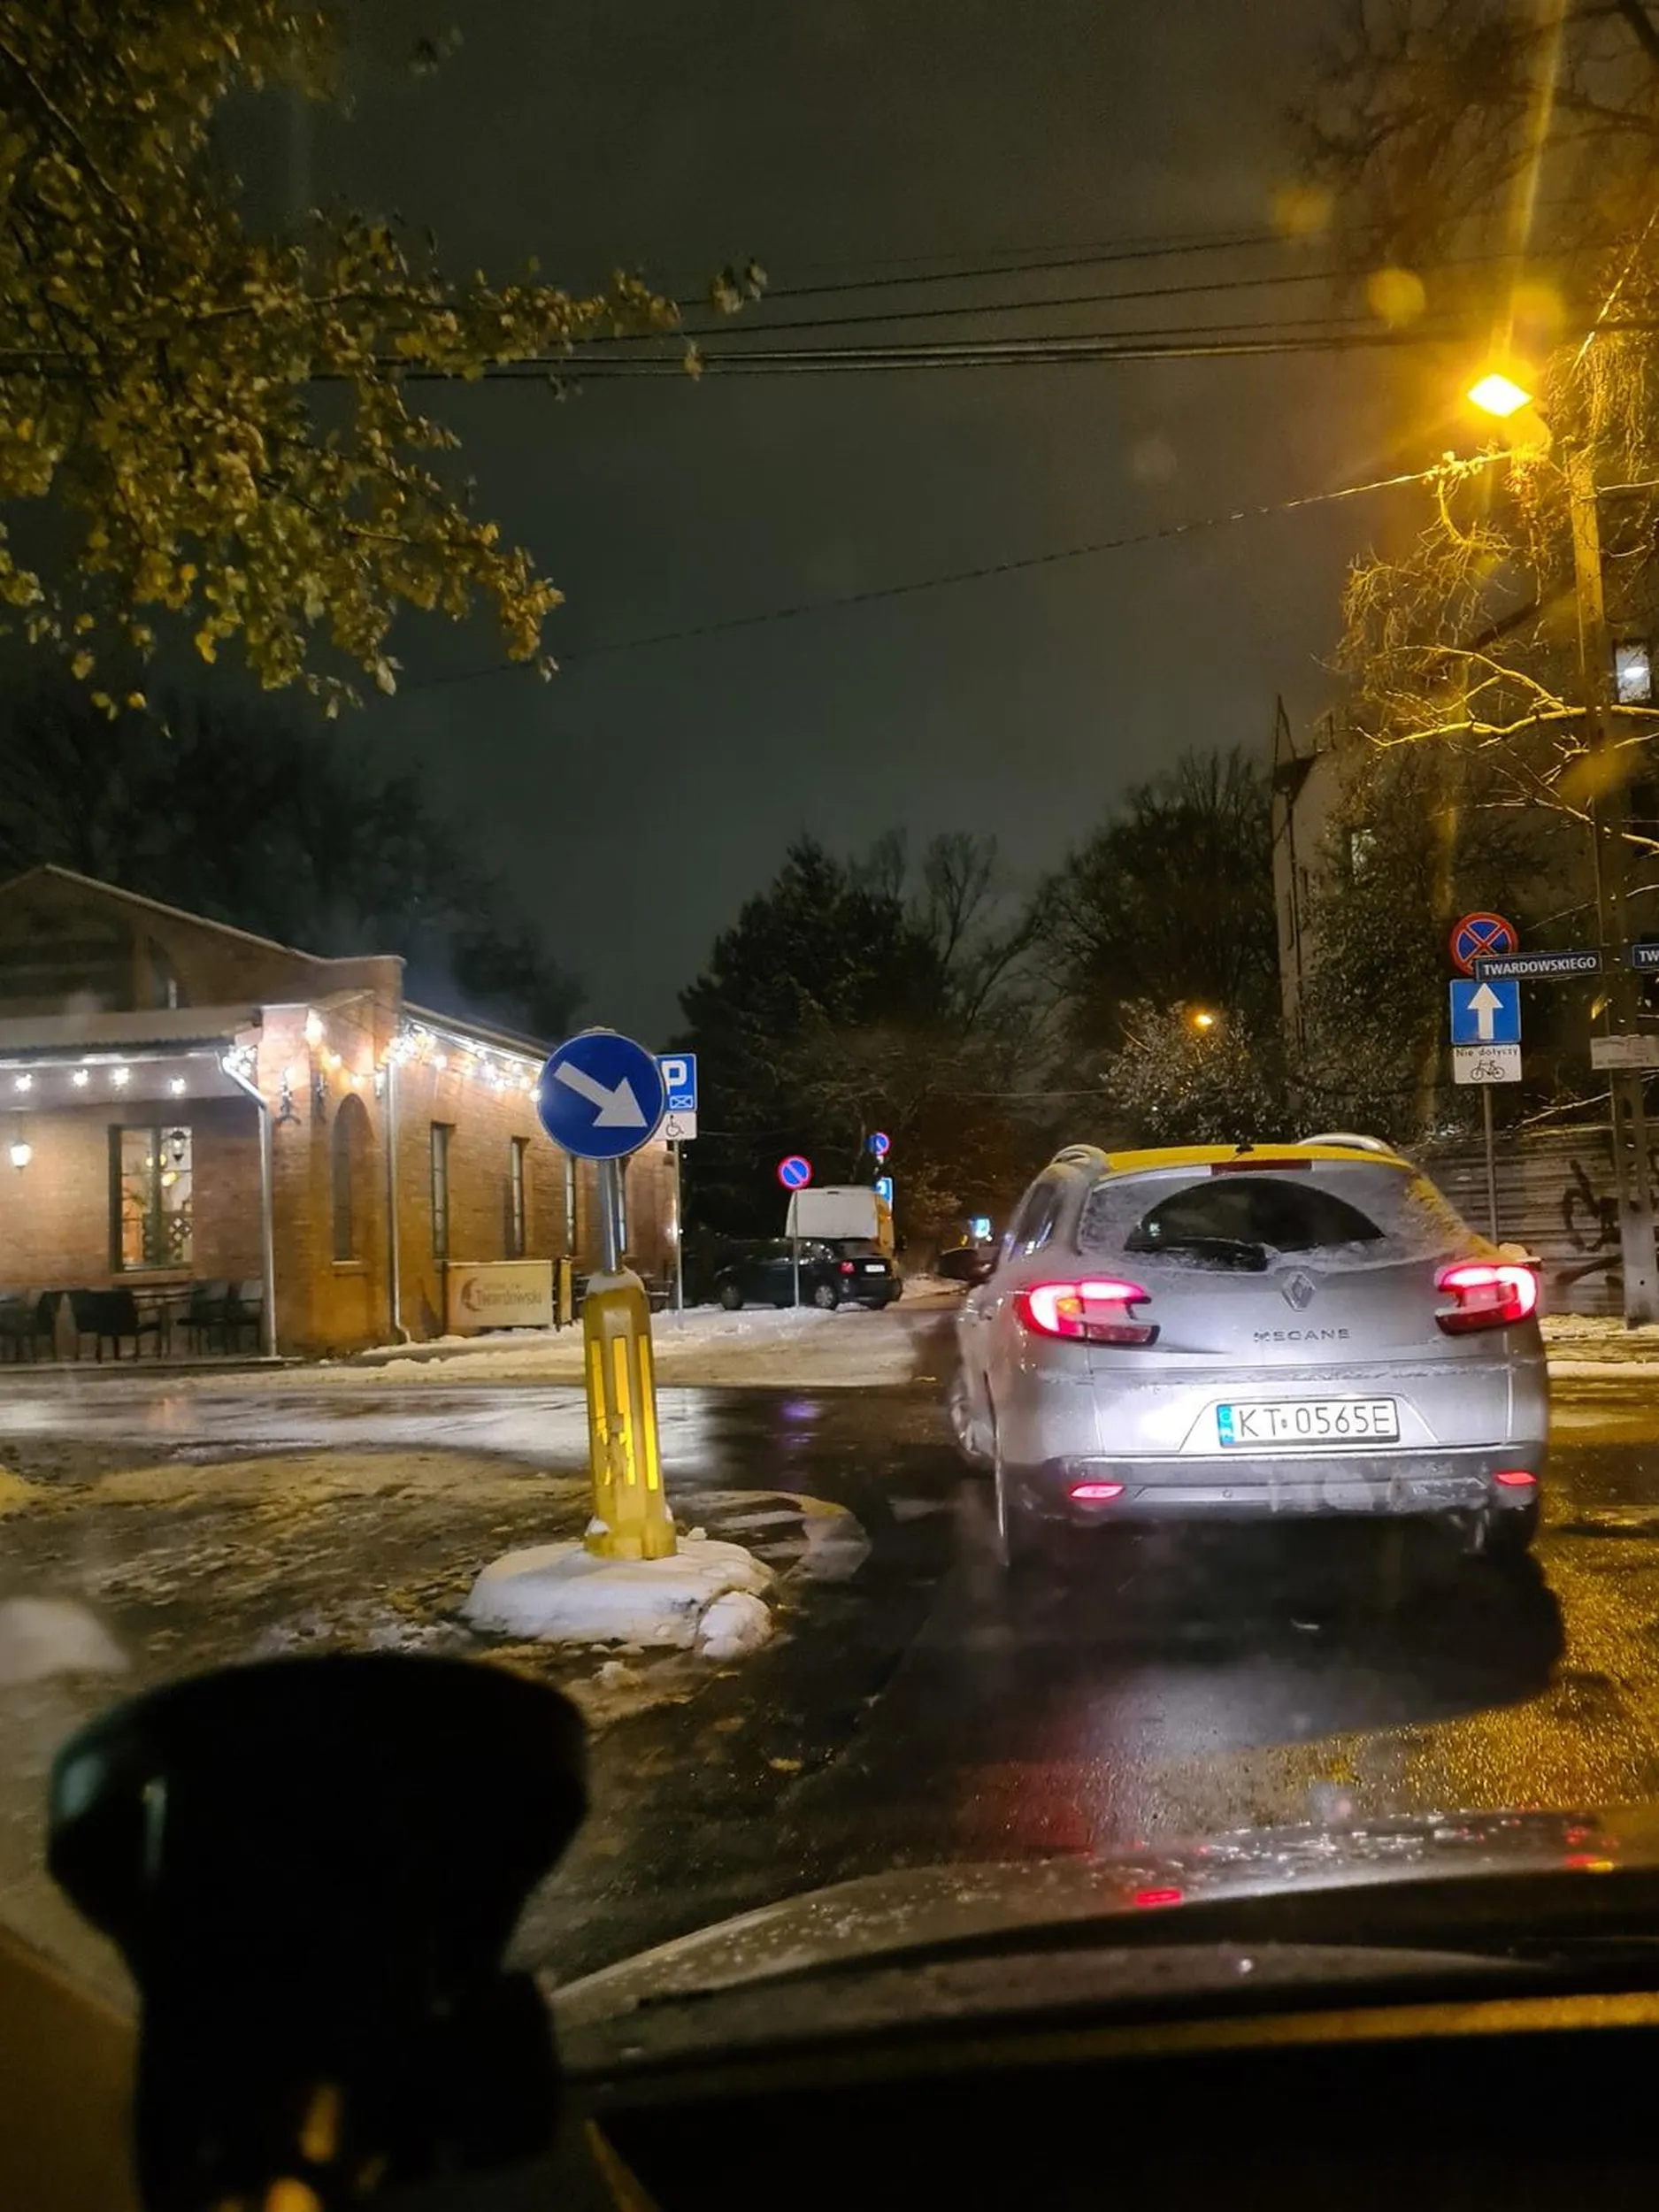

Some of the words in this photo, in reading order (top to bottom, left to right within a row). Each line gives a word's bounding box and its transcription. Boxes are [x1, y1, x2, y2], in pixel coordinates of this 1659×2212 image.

[1483, 956, 1596, 975] TWARDOWSKIEGO
[1455, 1048, 1474, 1057] Nie
[1479, 1047, 1518, 1056] dotyczy
[662, 1060, 687, 1095] P
[1254, 1328, 1351, 1342] MEGANE
[1239, 1408, 1281, 1438] KT
[1295, 1405, 1390, 1434] 0565E
